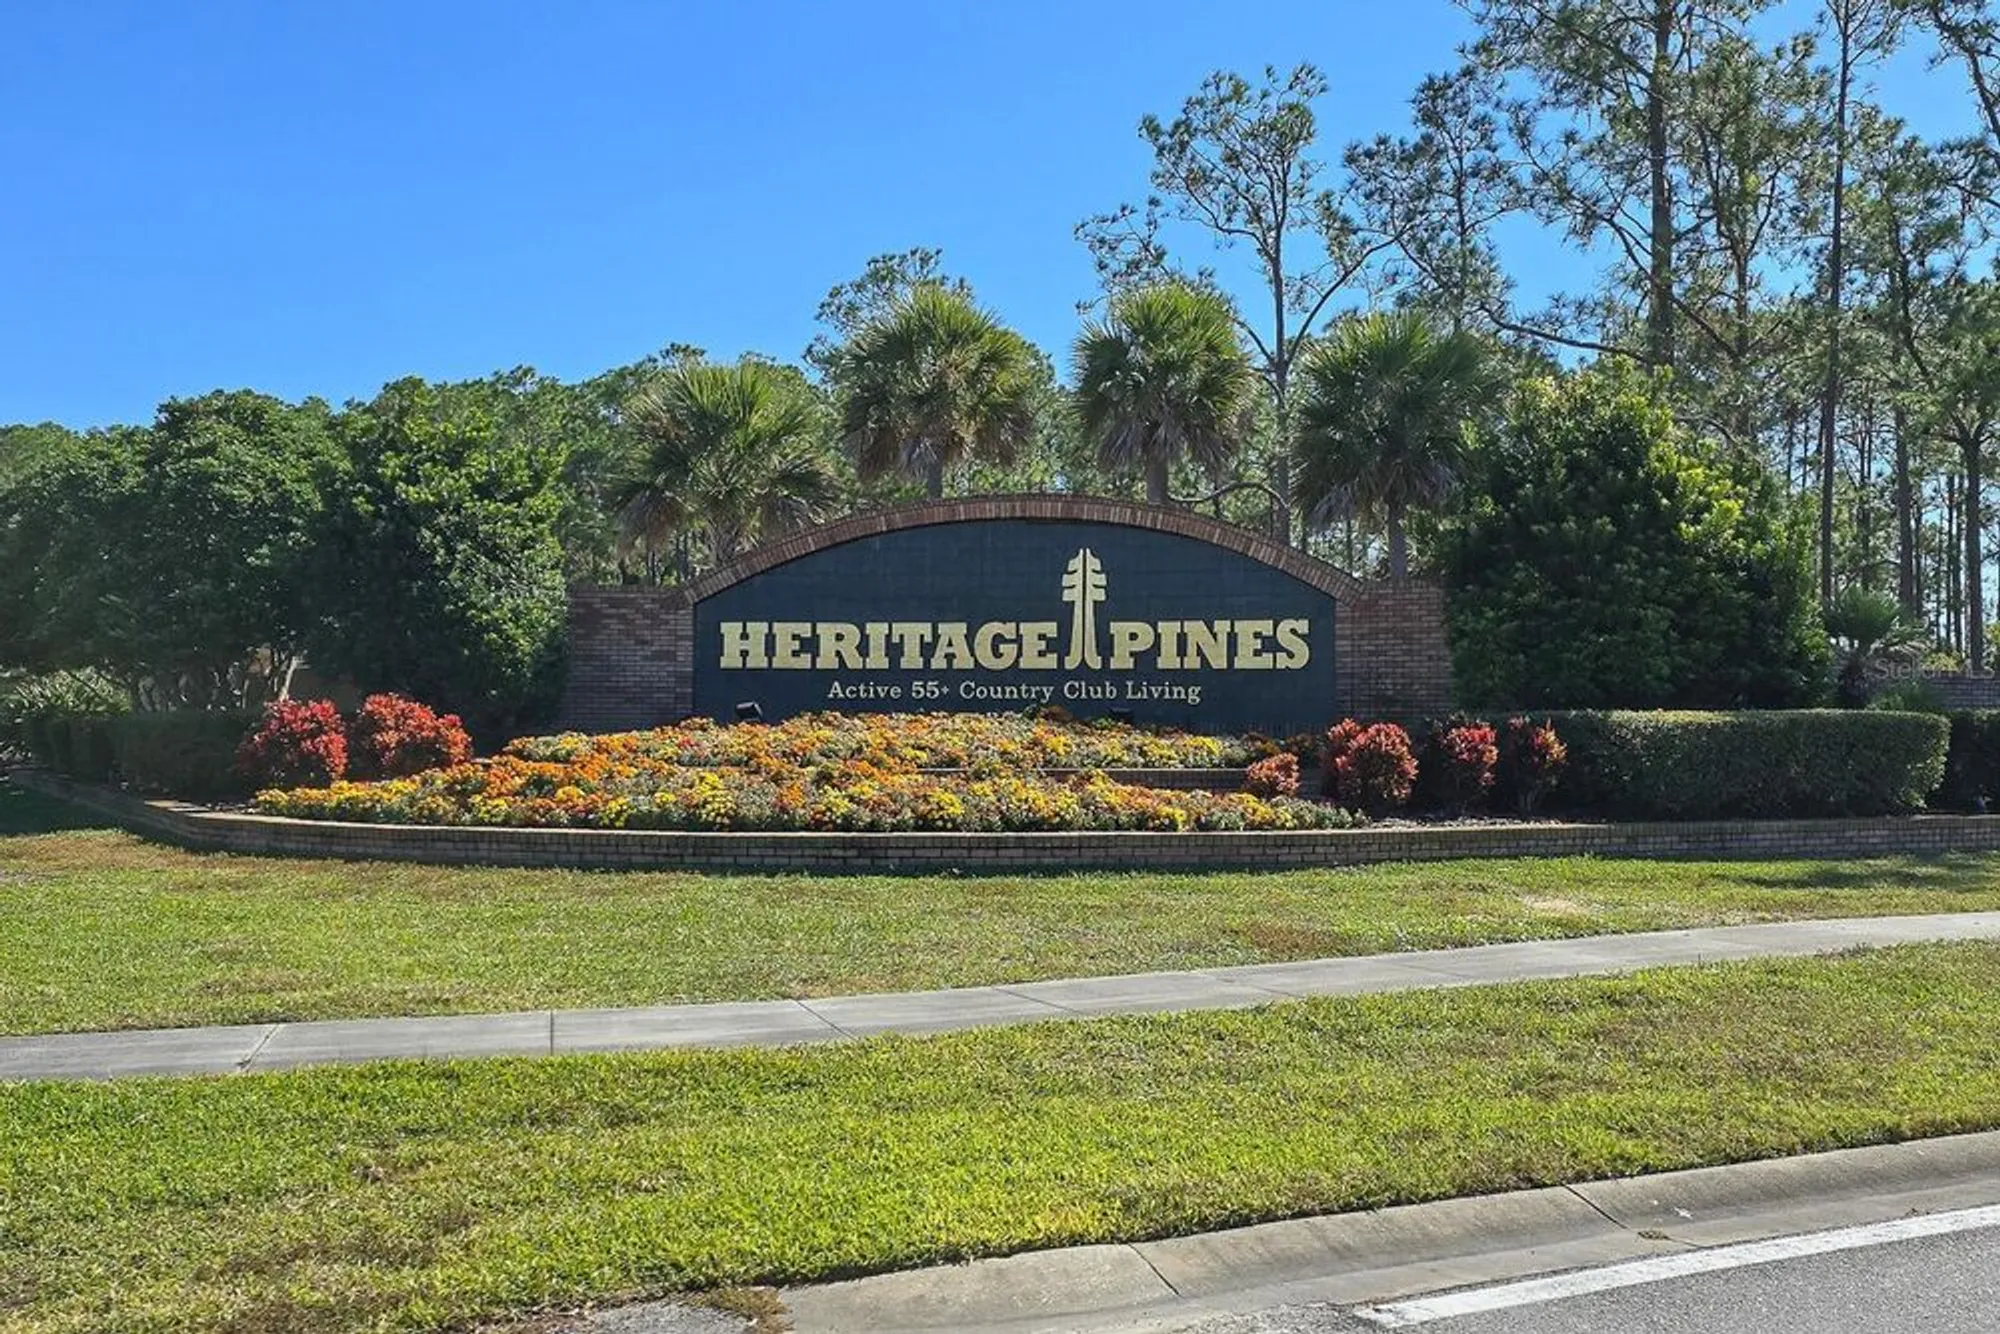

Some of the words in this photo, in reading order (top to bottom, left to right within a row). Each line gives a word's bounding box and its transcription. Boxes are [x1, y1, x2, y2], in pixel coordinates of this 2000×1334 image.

[720, 621, 1058, 670] HERITAGE
[1109, 618, 1310, 670] PINES
[827, 681, 902, 699] Active
[911, 681, 951, 699] 55+
[959, 680, 1054, 703] Country
[1063, 680, 1117, 699] Club
[1126, 680, 1201, 705] Living
